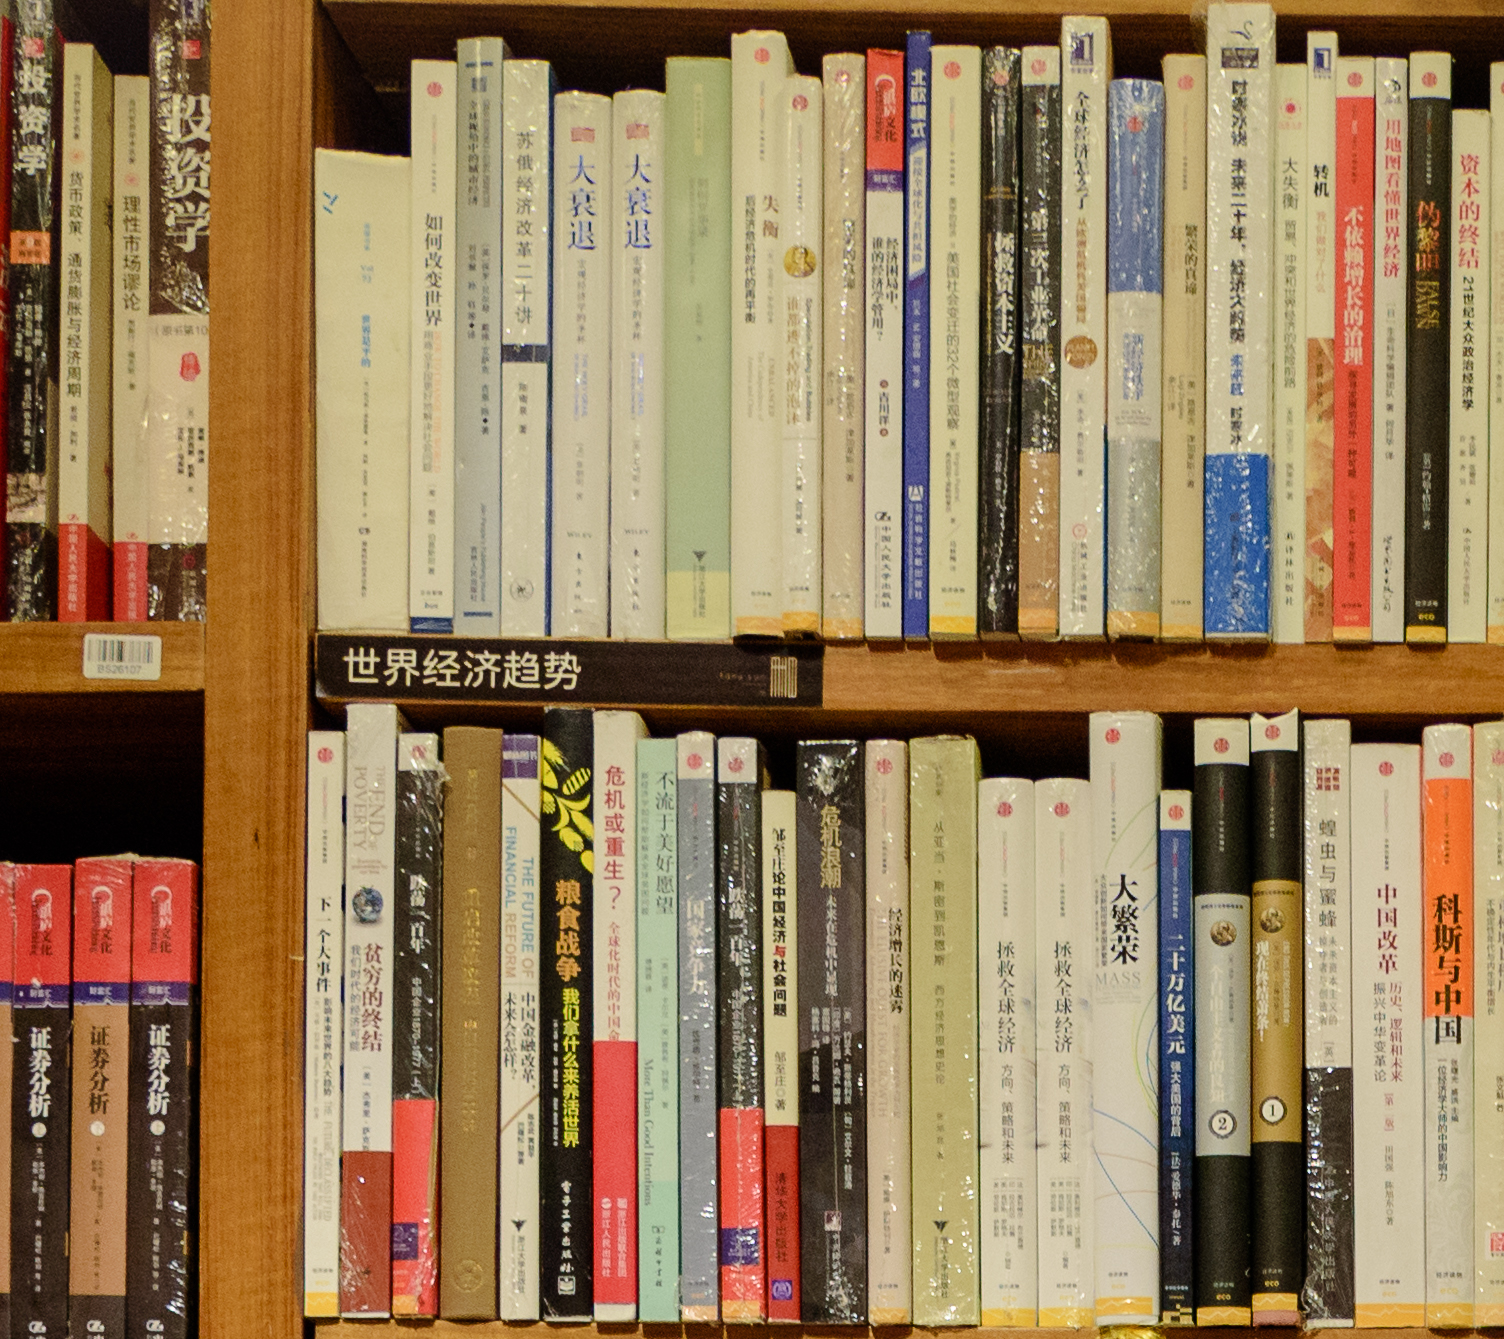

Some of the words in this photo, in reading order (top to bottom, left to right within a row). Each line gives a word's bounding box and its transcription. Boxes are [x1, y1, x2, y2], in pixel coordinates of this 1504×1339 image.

[567, 156, 596, 251] 大衰退
[1314, 165, 1329, 197] 转机
[1459, 154, 1481, 270] 资本的终结
[424, 212, 444, 328] 如何改变世界
[343, 647, 582, 691] 世界经济趋势
[555, 881, 580, 981] 粮食战争
[1110, 874, 1138, 964] 大繁荣
[1377, 885, 1398, 974] 中国改革
[1434, 893, 1462, 1044] 科斯与中国
[362, 943, 384, 1052] 贫穷的终结
[1167, 935, 1186, 1054] 二十万亿美元
